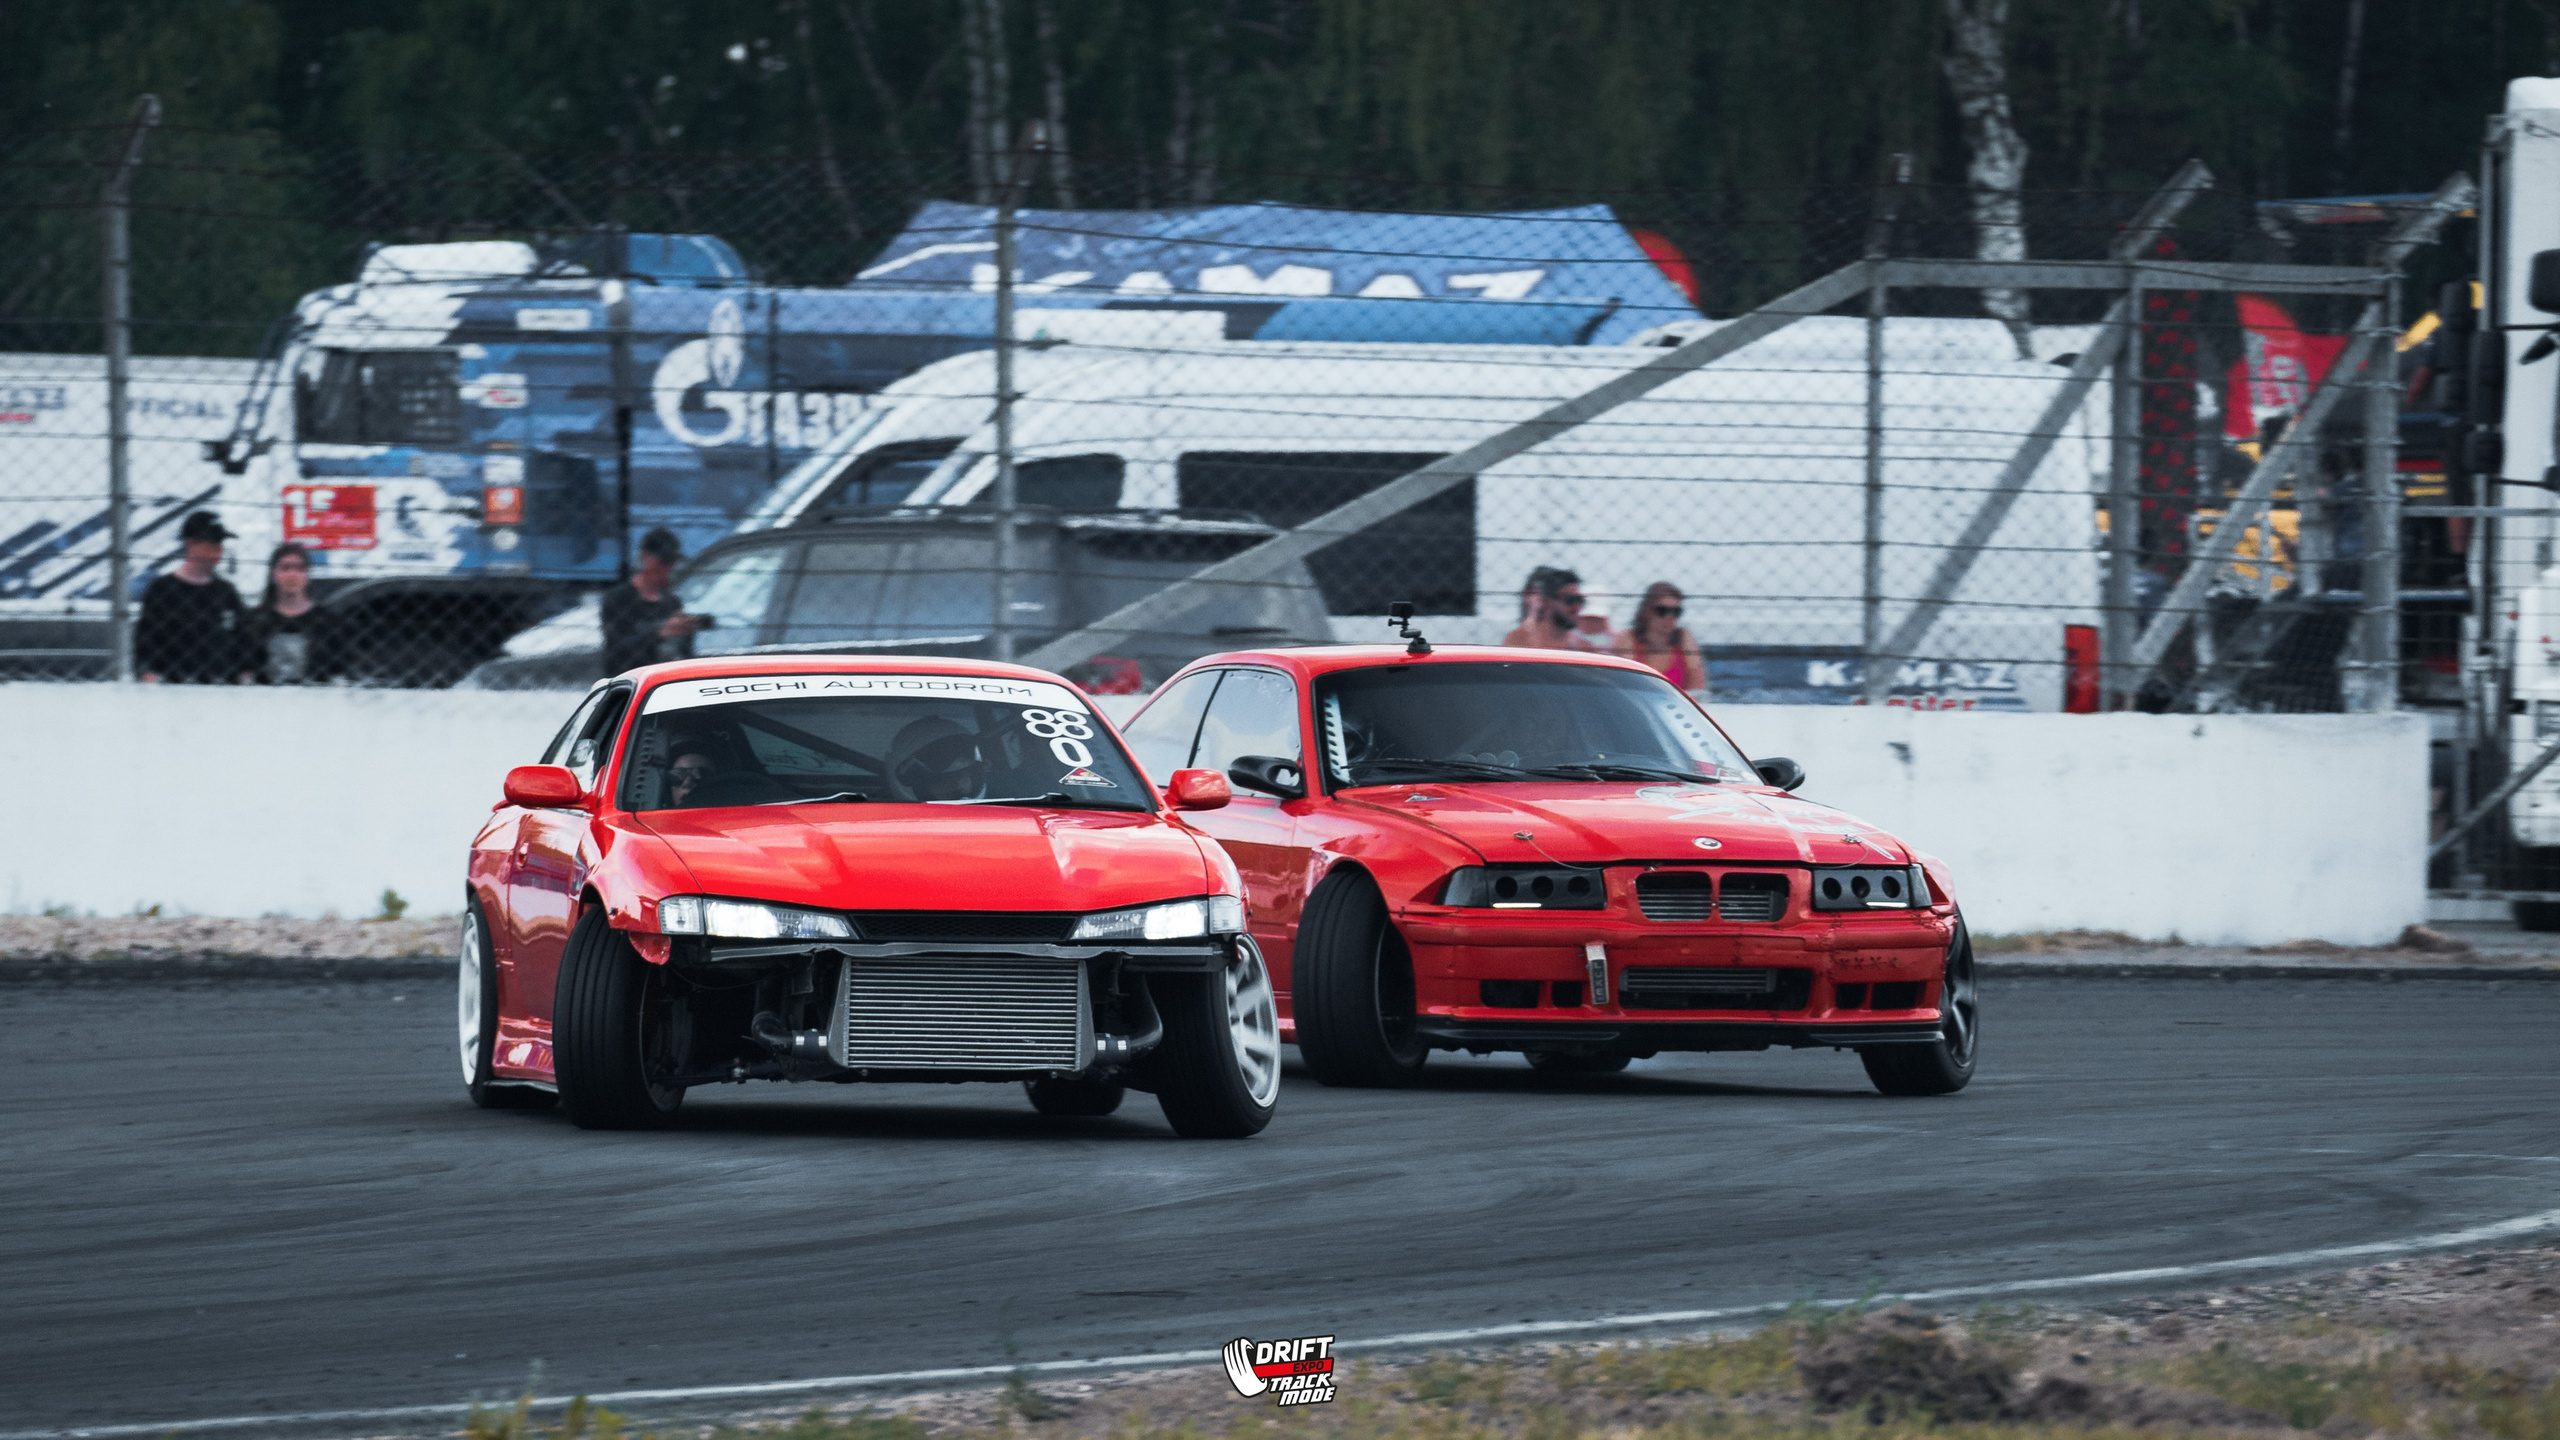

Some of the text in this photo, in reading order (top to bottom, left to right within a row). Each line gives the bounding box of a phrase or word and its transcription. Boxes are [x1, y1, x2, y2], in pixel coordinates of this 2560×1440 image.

[699, 680, 1033, 697] SOCHI AUTODROM
[1806, 659, 2017, 688] KMAZ
[1021, 708, 1095, 740] 88
[1049, 737, 1094, 768] 0
